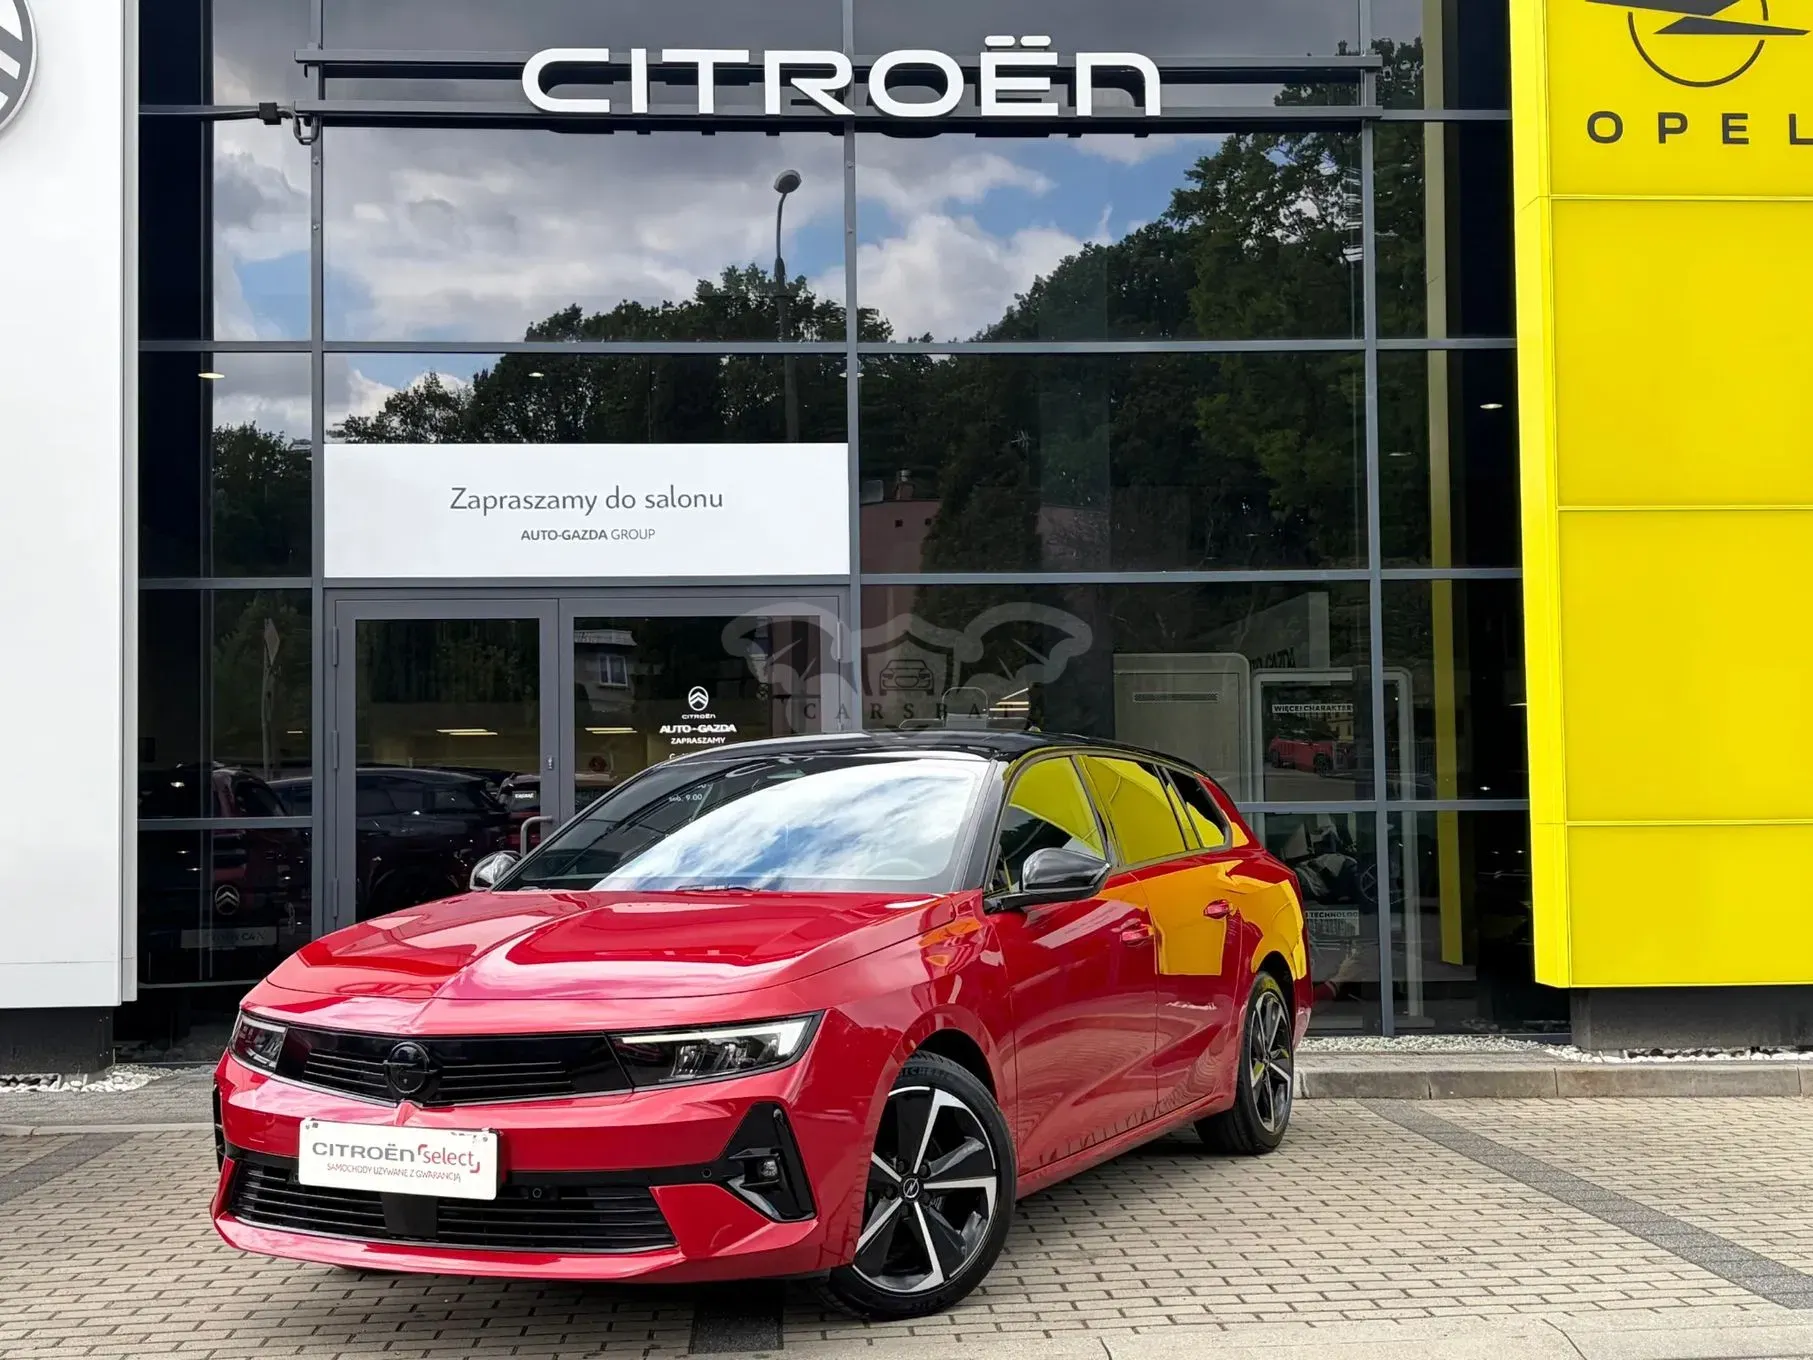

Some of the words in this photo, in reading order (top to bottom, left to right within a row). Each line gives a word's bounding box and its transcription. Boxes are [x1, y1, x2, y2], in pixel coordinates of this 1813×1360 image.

[522, 35, 1161, 117] CITROËN
[1587, 110, 1813, 145] OPEL
[450, 486, 598, 516] Zapraszamy
[605, 485, 637, 509] do
[645, 484, 723, 509] salonu
[521, 529, 608, 541] AUTO-GAZDA
[611, 528, 656, 541] GROUP
[670, 736, 727, 745] ZAPRASZAMY
[312, 1142, 415, 1163] CITROËN
[422, 1147, 476, 1167] select
[327, 1162, 372, 1174] SAMOCHODY
[409, 1169, 414, 1178] Z
